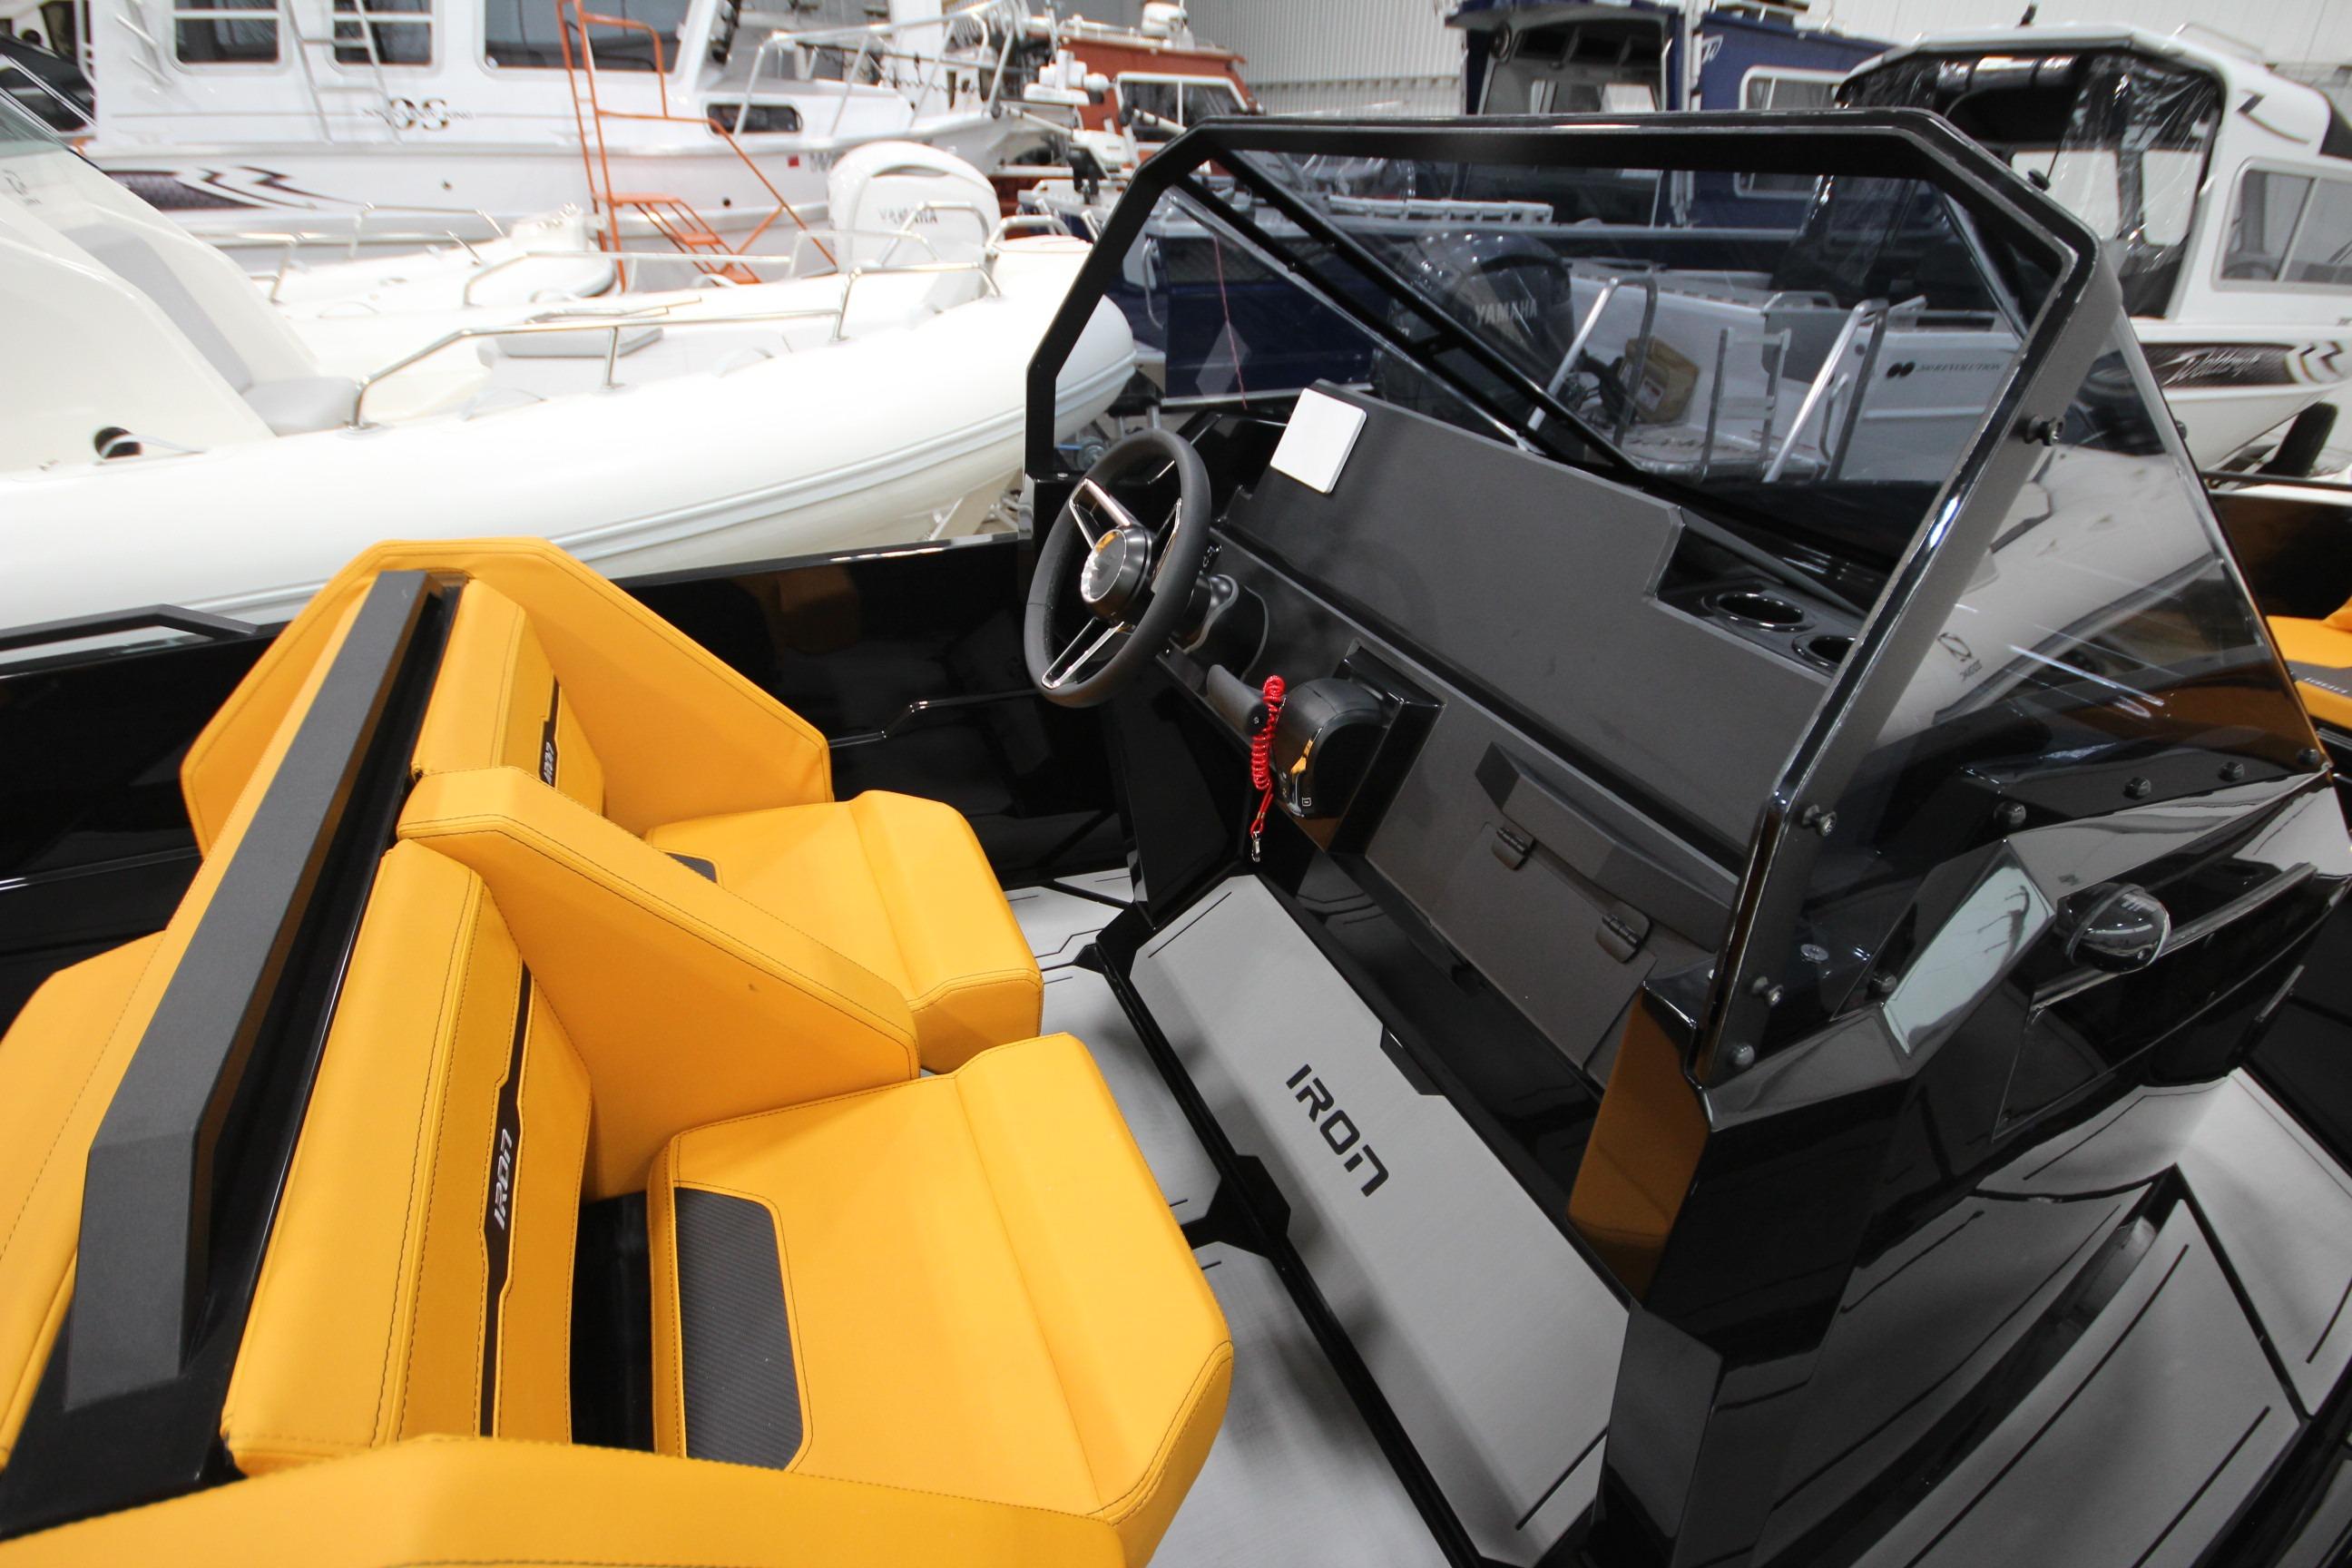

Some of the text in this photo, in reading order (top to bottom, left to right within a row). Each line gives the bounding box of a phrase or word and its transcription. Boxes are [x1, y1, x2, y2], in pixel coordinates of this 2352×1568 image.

[1475, 298, 1538, 328] YAMAHA
[493, 1127, 513, 1231] IRON
[1285, 1063, 1390, 1198] IRON
